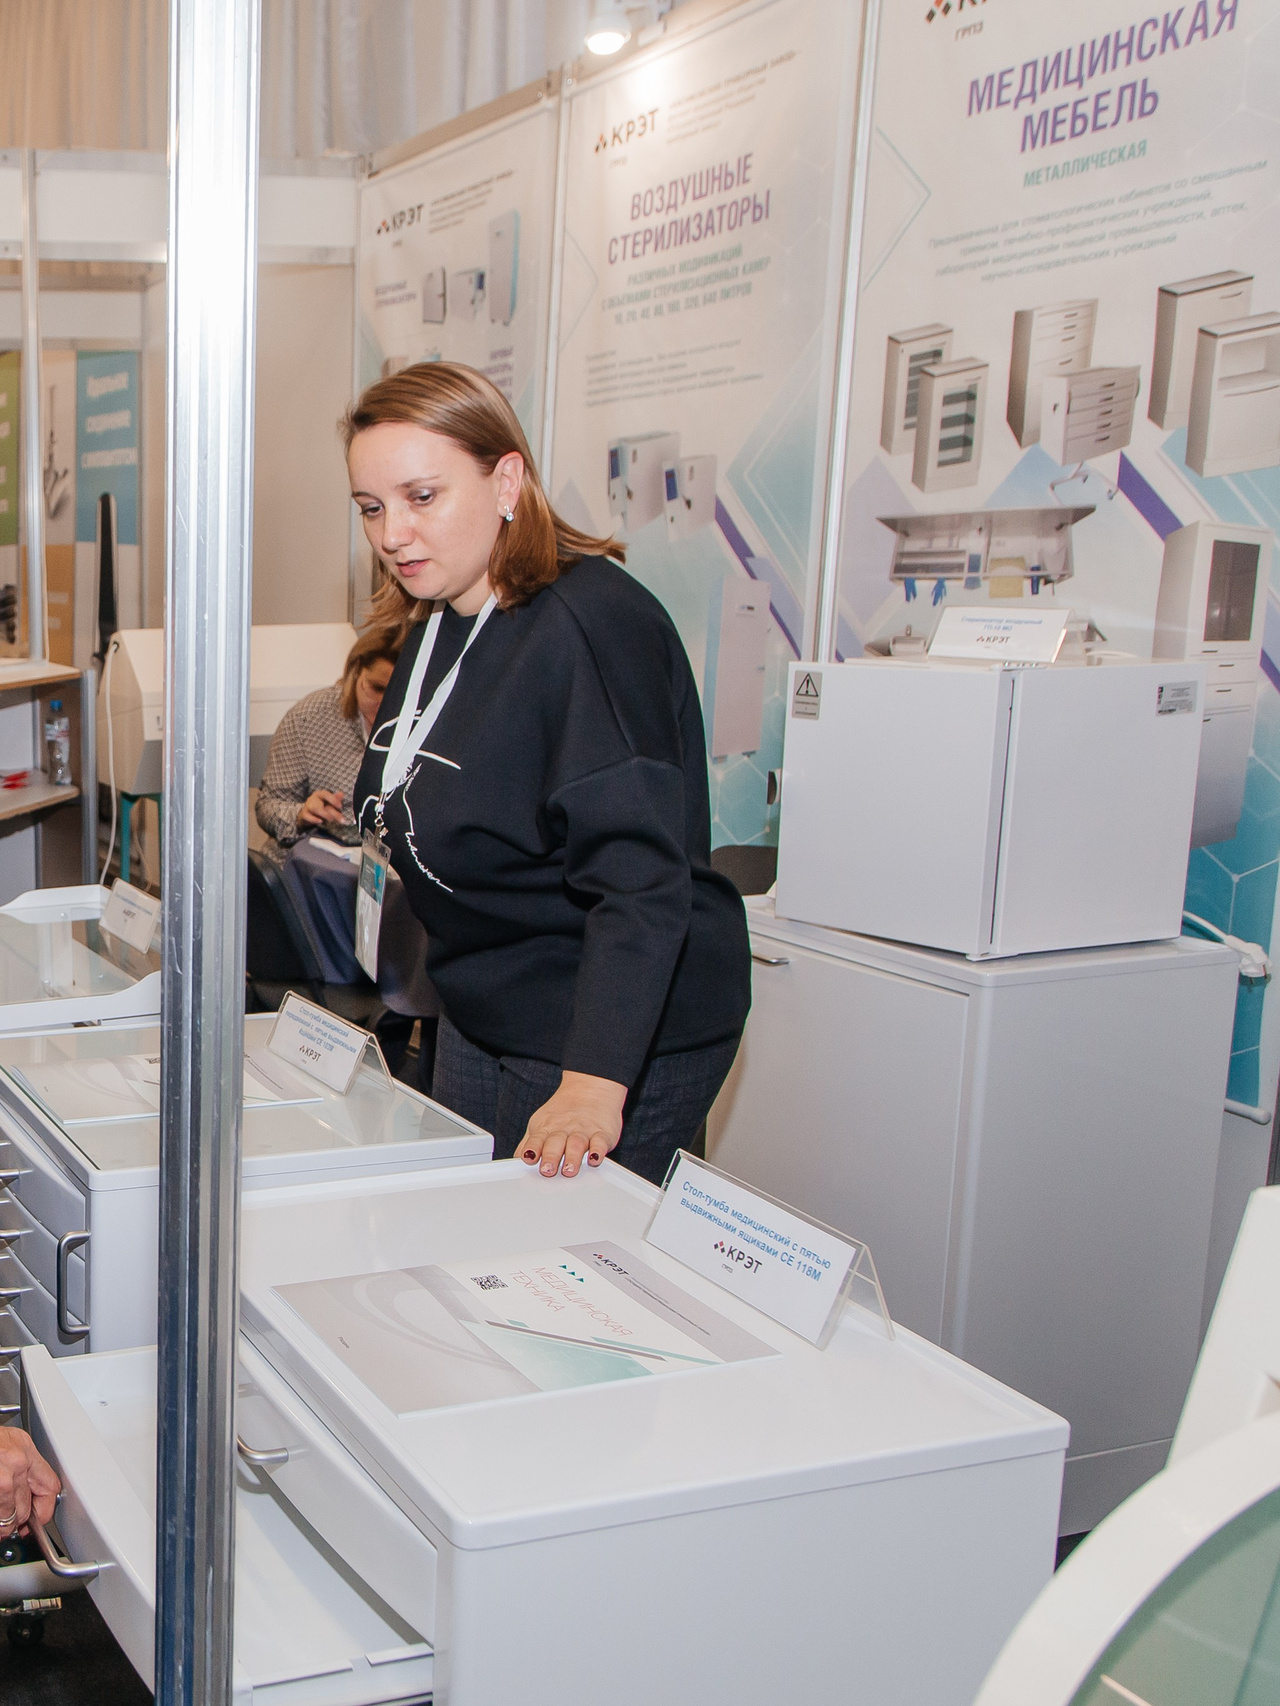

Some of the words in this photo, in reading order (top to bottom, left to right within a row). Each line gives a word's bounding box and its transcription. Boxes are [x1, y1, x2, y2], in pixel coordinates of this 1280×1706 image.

[967, 0, 1238, 117] МЕДИЦИНСКАЯ
[610, 108, 659, 147] КРЭТ
[1020, 77, 1160, 152] МЕБЕЛЬ
[631, 152, 753, 221] ВОЗДУШНЫЕ
[1023, 139, 1147, 188] МЕТАЛЛИЧЕСКАЯ
[391, 203, 424, 232] КРЭТ
[607, 189, 771, 264] СТЕРИЛИЗАТОРЫ
[305, 1046, 322, 1062] КРЭТ
[680, 1197, 738, 1236] выдвижными
[736, 1229, 779, 1258] ящиками
[780, 1251, 796, 1268] СЕ
[796, 1259, 822, 1283] 118М
[682, 1181, 731, 1214] Стол-тумба
[731, 1208, 792, 1248] медицинский
[791, 1242, 799, 1252] с
[799, 1246, 832, 1270] пятью
[601, 1258, 630, 1276] КРЭТ
[726, 1245, 763, 1274] КРЭТ
[508, 1269, 566, 1313] ТЕХНИКА
[531, 1267, 634, 1337] МЕДИЦИНСКАЯ
